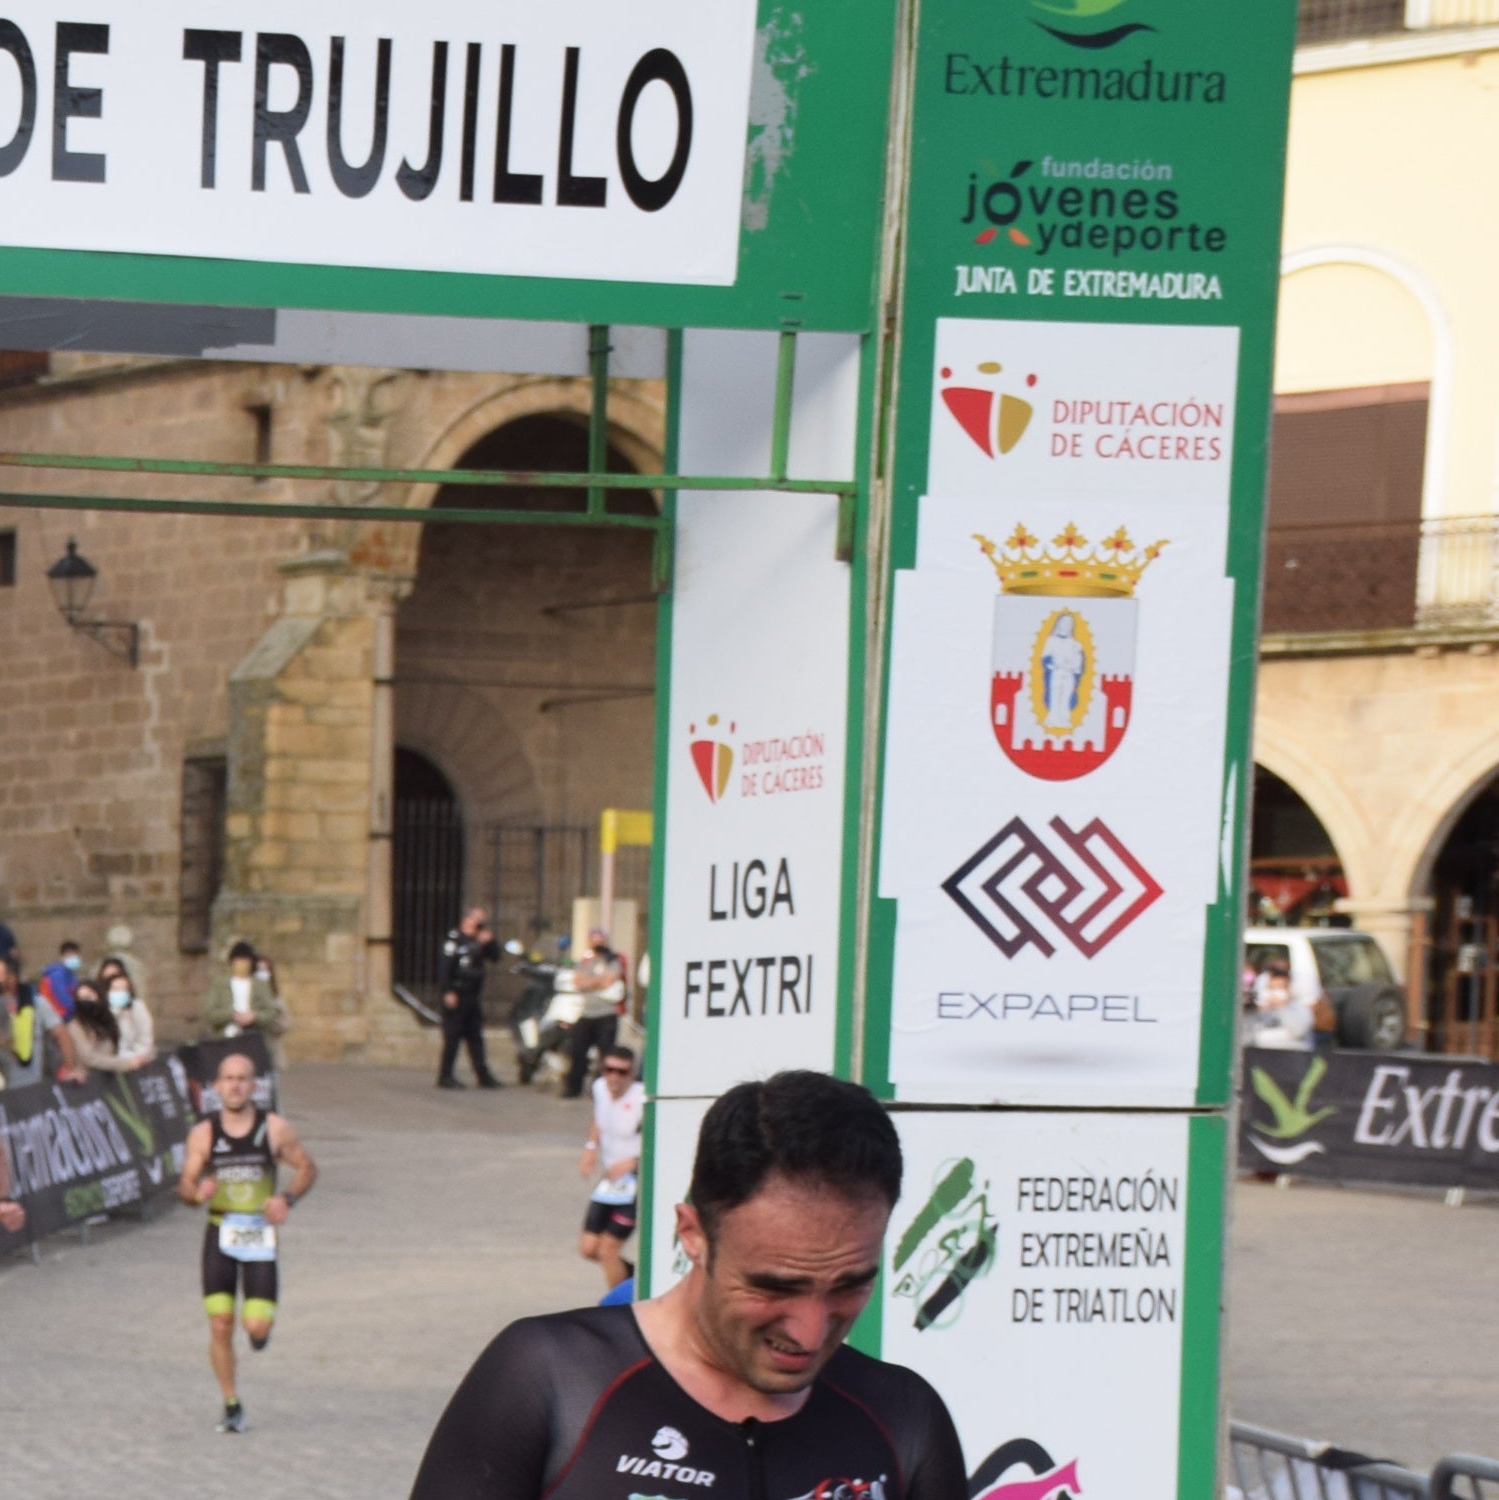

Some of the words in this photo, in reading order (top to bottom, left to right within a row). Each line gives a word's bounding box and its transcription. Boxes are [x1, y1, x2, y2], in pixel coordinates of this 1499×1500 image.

[944, 53, 1226, 103] Extremadura
[183, 28, 693, 213] TRUJILLO
[1042, 156, 1173, 181] fundación
[961, 160, 1180, 225] jóvenes
[1036, 219, 1227, 257] ydeporte
[955, 265, 1017, 297] JUNTA
[1027, 268, 1055, 296] DE
[1064, 269, 1222, 300] EXTREMADURA
[1053, 397, 1224, 428] DIPUTACIÓN
[1050, 433, 1082, 458] DE
[1095, 429, 1222, 461] CÁCERES
[742, 729, 825, 766] DIPUTACIÓN
[741, 774, 757, 797] DE
[763, 765, 823, 795] CÁCERES
[709, 857, 795, 921] LIGA
[683, 954, 813, 1018] FEXTRI
[937, 992, 1159, 1024] EXPAPEL
[1017, 1169, 1178, 1213] FEDERACIÓN
[1020, 1228, 1171, 1268] EXTREMEÑA
[1011, 1289, 1044, 1322] DE
[1053, 1287, 1176, 1324] TRIATLON
[616, 1454, 716, 1488] VIATOR
